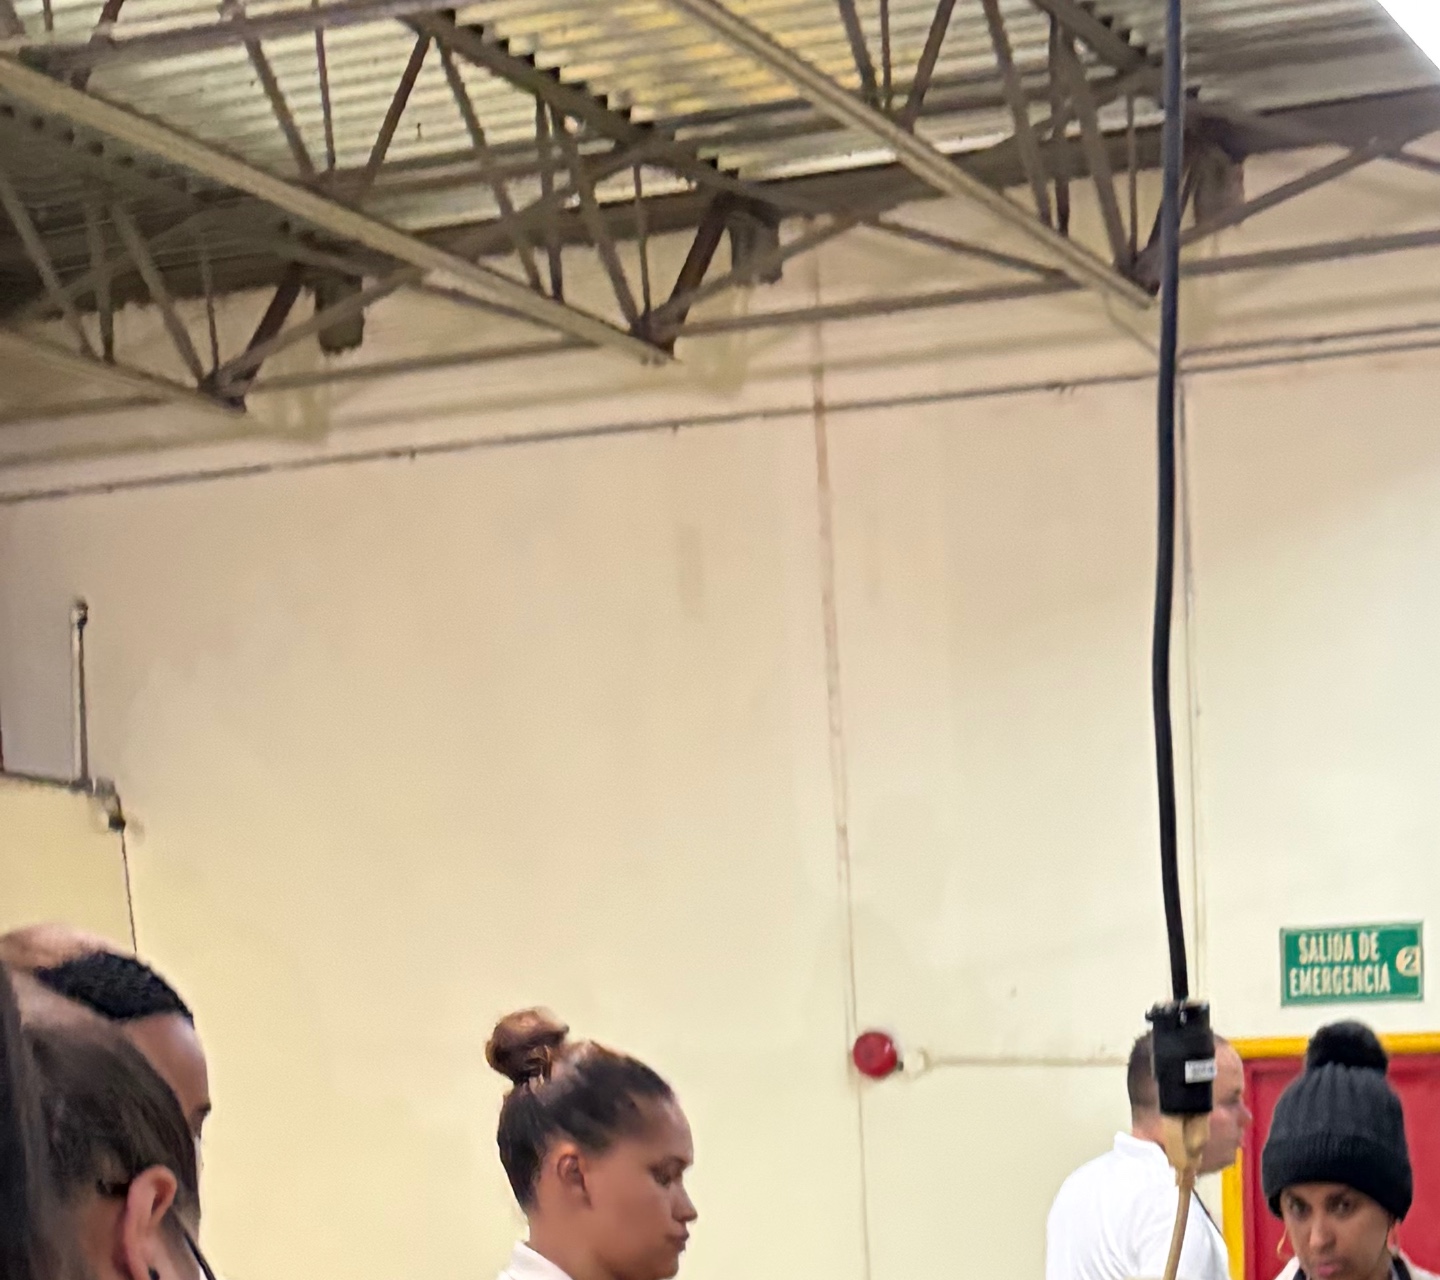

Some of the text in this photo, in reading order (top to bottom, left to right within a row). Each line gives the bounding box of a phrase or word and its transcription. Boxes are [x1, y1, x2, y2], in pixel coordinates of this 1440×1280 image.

[1298, 931, 1381, 965] SALIDA DE
[1289, 961, 1391, 997] EMERGENCIA
